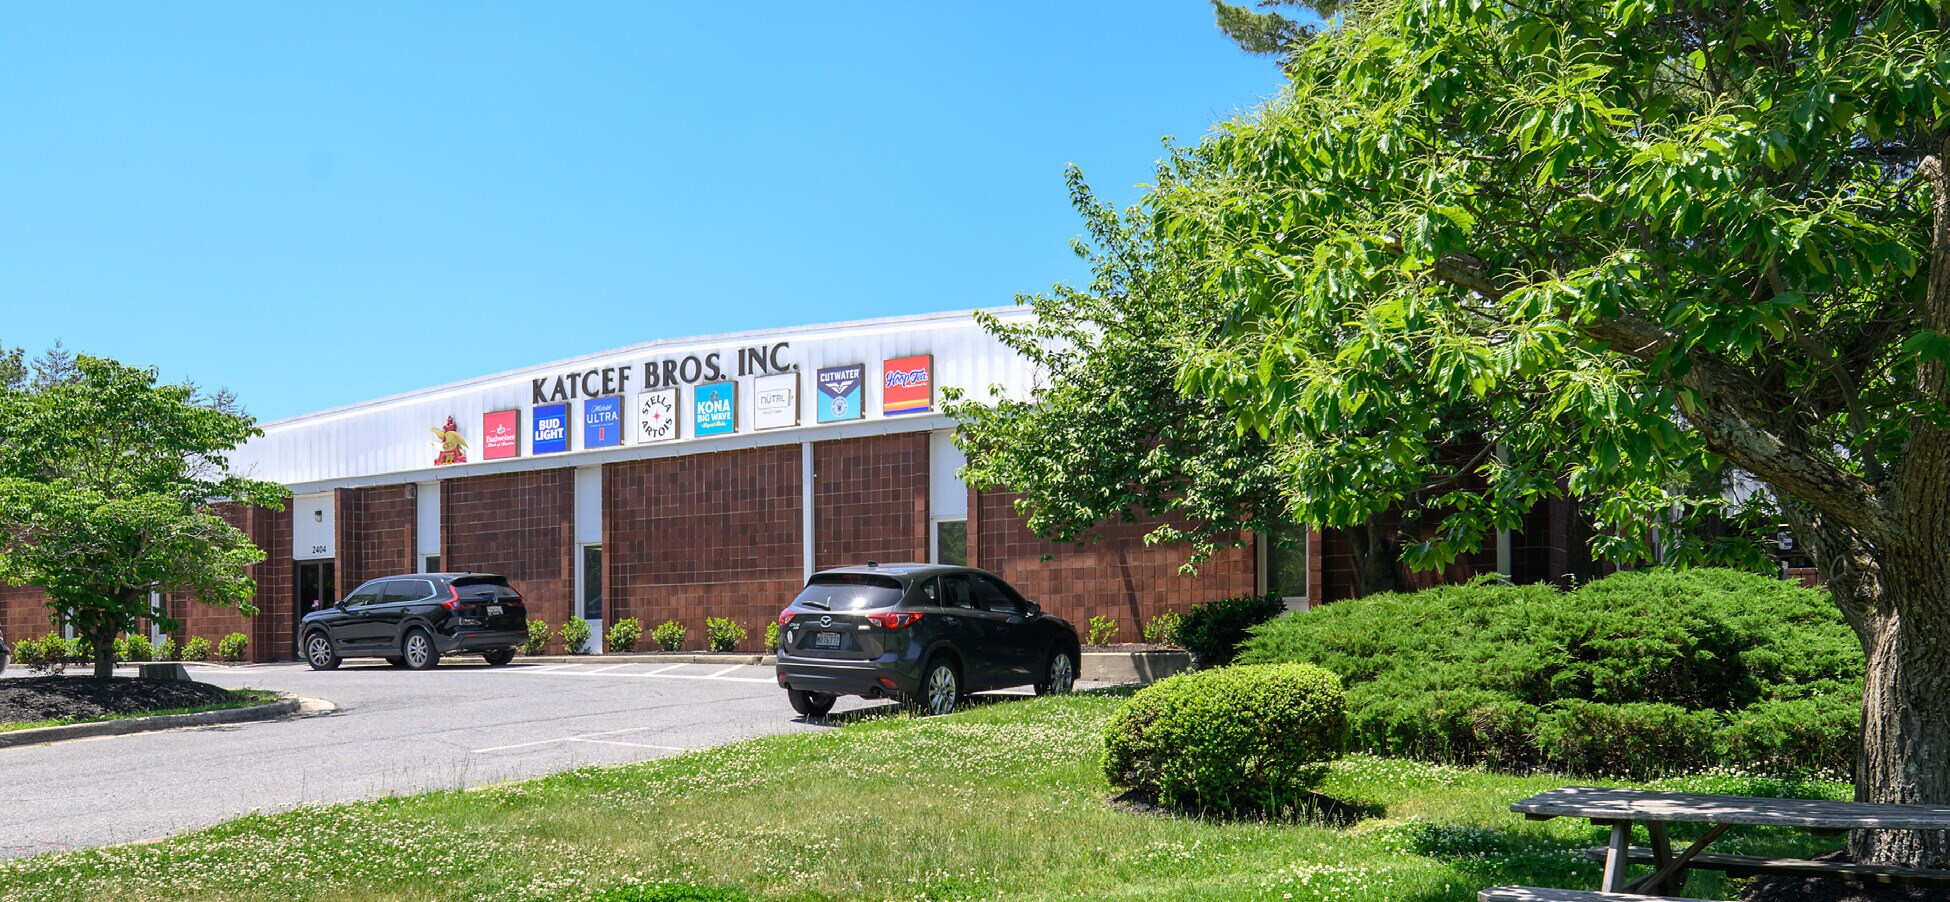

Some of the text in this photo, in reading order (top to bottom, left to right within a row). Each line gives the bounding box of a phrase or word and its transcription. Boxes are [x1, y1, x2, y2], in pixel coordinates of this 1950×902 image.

[532, 342, 799, 405] KATCEF BROS. INC.
[820, 368, 860, 382] CUTWATER
[885, 367, 928, 388] Hoop Tea
[642, 394, 672, 415] STELLA
[697, 399, 731, 415] KONA
[586, 411, 618, 424] ULTRA
[697, 411, 731, 423] BIG WAVE
[538, 418, 560, 431] BUD
[641, 418, 672, 438] ARTOIS
[534, 427, 565, 441] LIGHT
[312, 545, 327, 554] 2404
